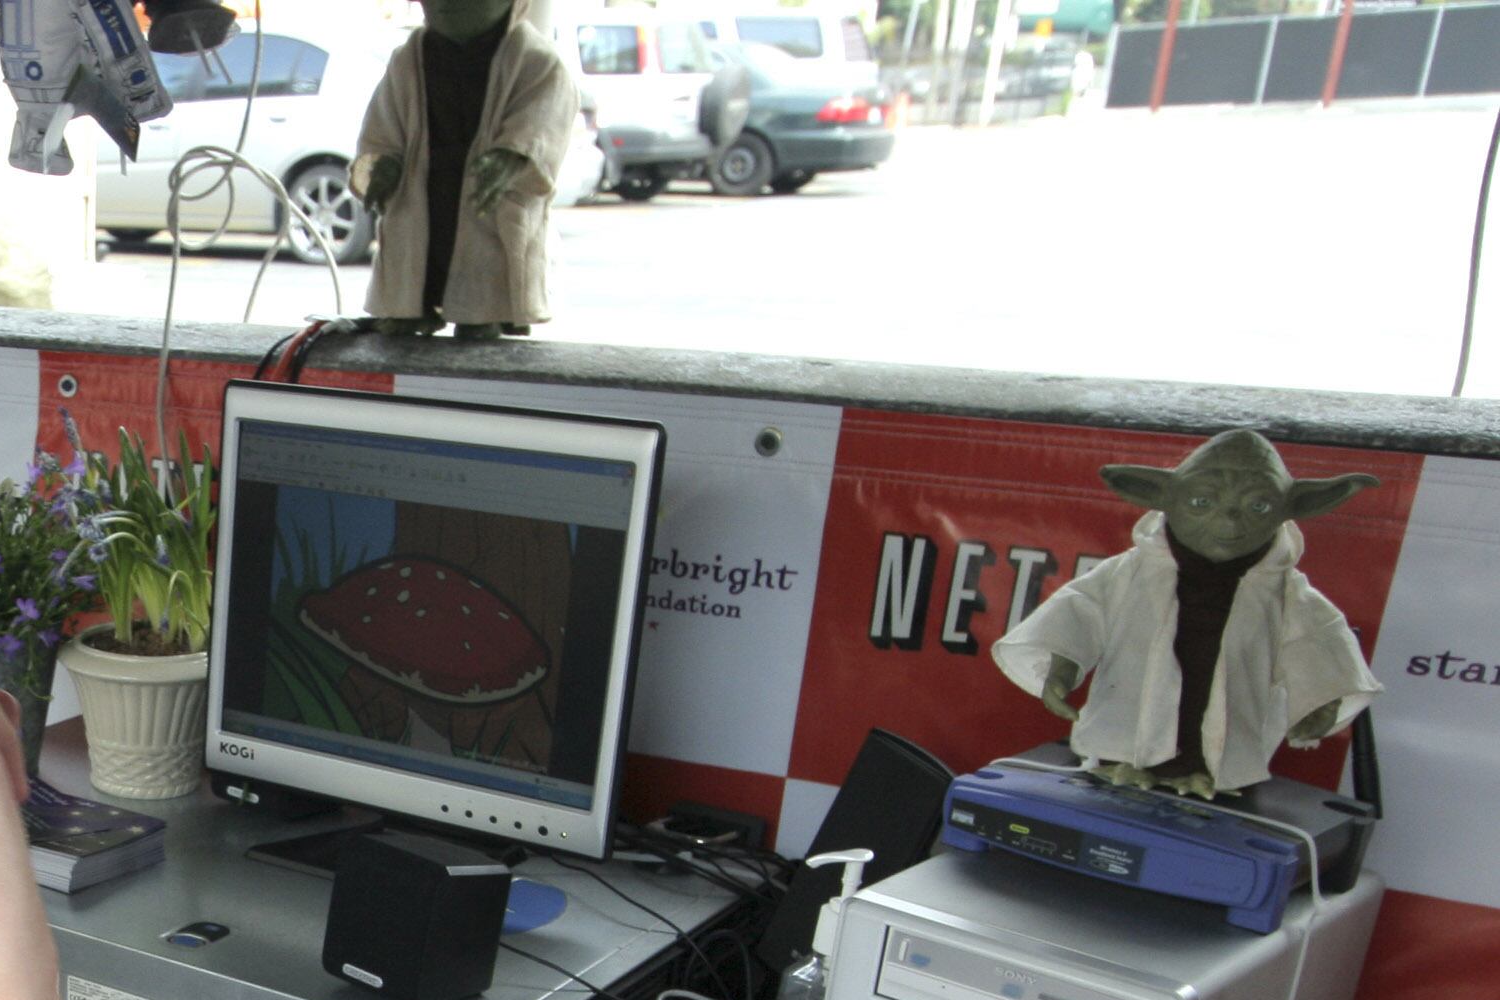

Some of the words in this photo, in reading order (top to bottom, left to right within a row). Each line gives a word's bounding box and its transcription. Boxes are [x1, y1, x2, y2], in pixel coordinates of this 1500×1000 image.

[650, 549, 798, 595] rbright
[644, 590, 742, 618] ndation
[868, 531, 1100, 652] NET
[995, 966, 1037, 985] SONY
